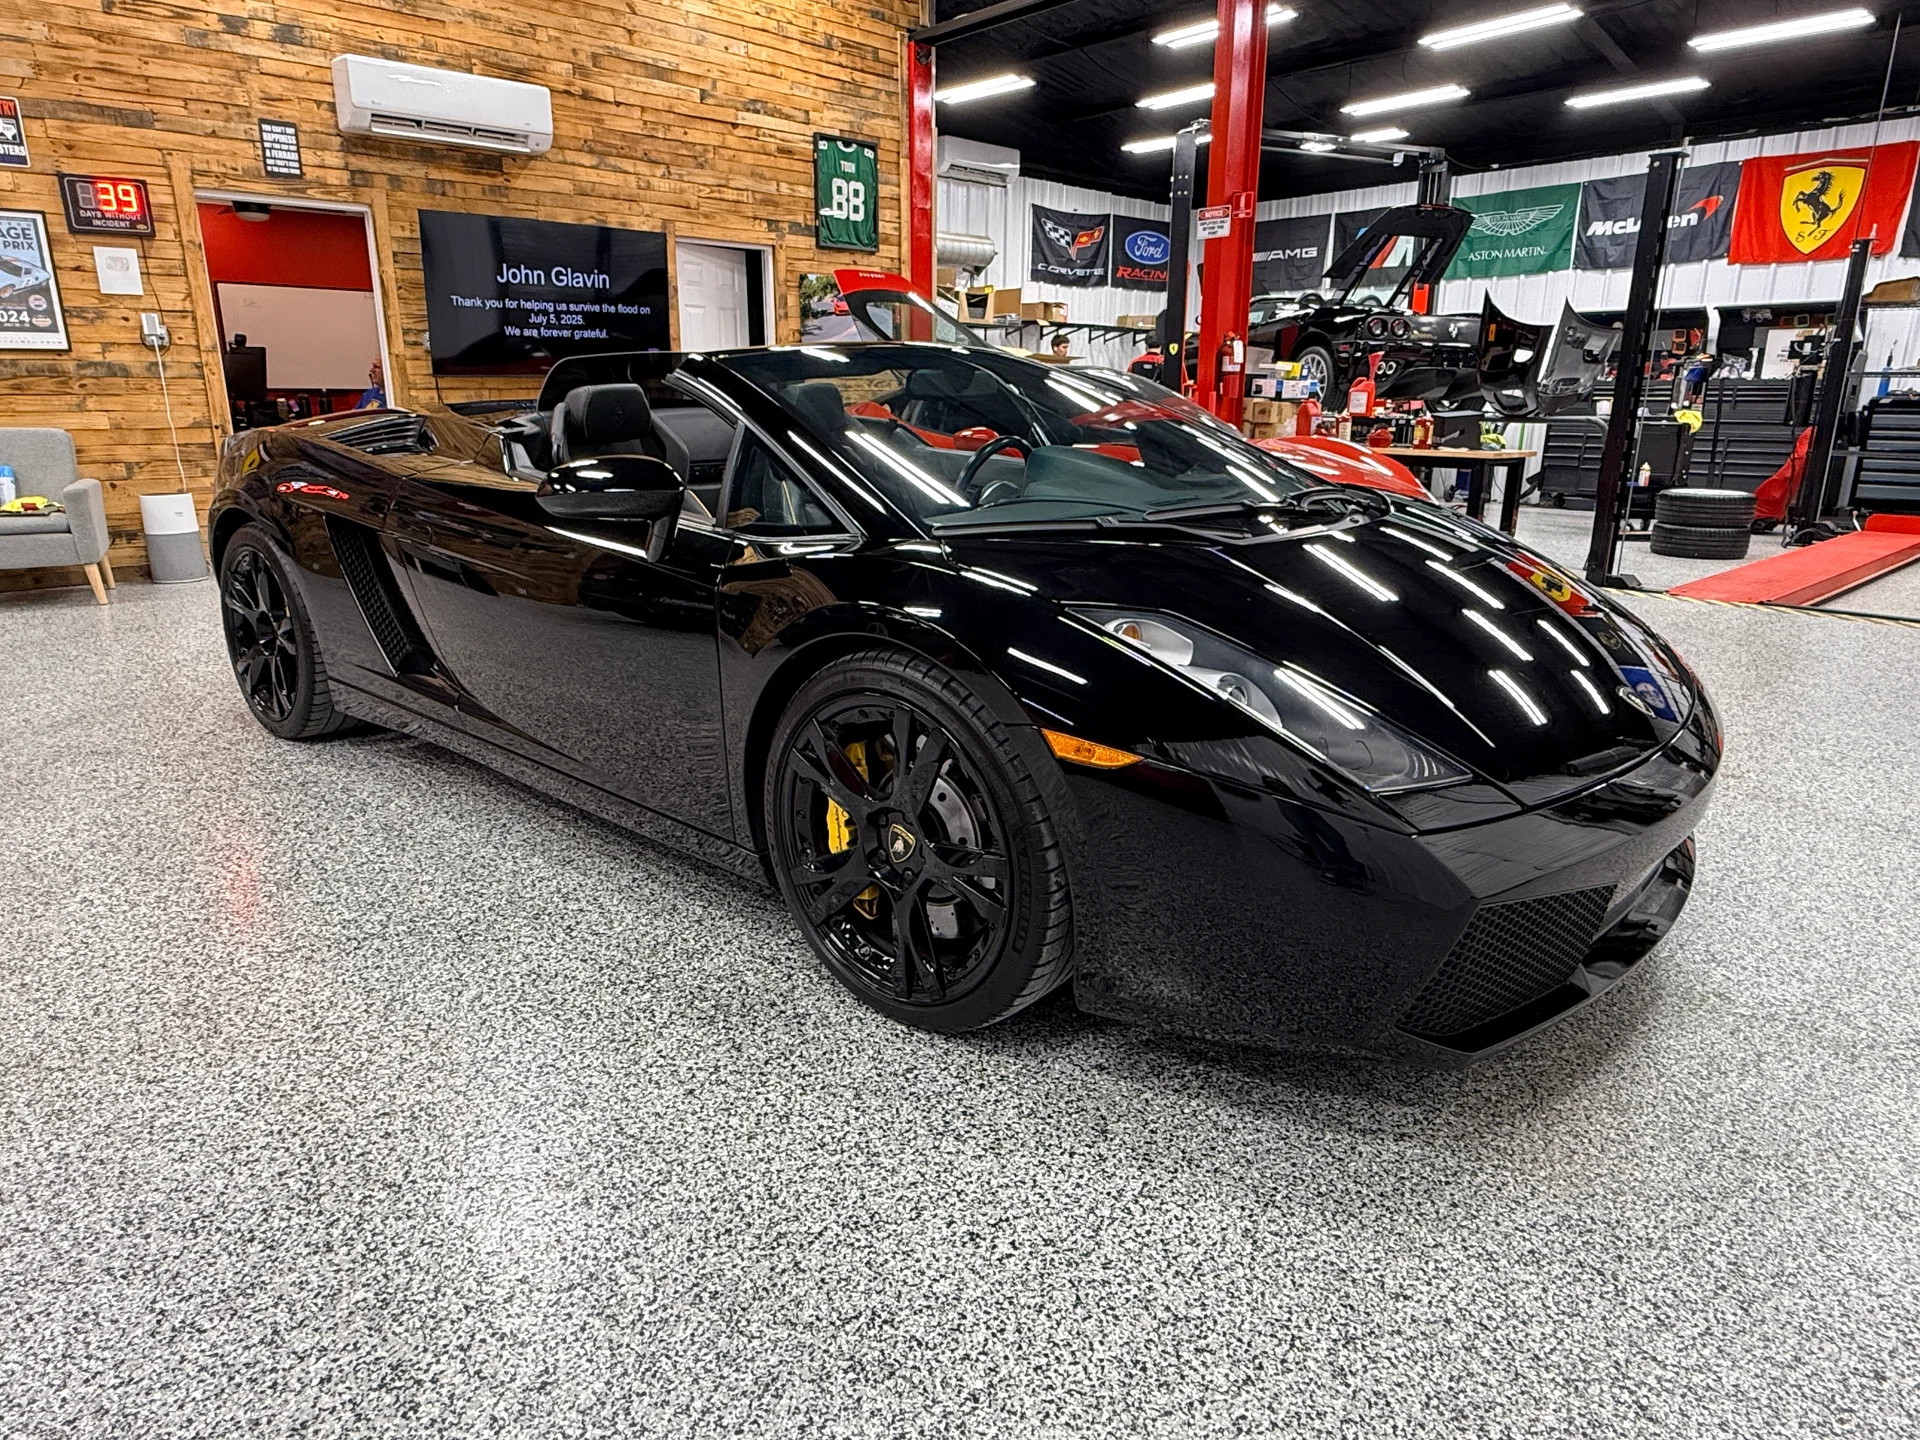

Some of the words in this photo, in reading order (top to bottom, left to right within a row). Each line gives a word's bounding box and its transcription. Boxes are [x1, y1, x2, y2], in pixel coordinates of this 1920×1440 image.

[262, 132, 297, 144] HAPPINESS
[271, 150, 299, 160] FERRARI
[97, 183, 138, 212] 39
[832, 178, 864, 221] 88
[79, 209, 102, 218] DAYS
[104, 211, 141, 220] WITHOUT
[1205, 210, 1223, 218] NOTICE
[92, 218, 130, 228] INCIDENT
[1586, 212, 1698, 236] McLen
[1795, 231, 1805, 243] S
[3, 240, 36, 251] PRIX
[1134, 234, 1165, 258] Ford
[1268, 247, 1318, 261] AMG
[1467, 250, 1503, 261] ASTON
[1504, 246, 1545, 258] MARTIN
[496, 263, 545, 285] John
[551, 266, 610, 289] Glavin
[1038, 262, 1105, 276] CORVETTE
[1116, 266, 1168, 280] RACIN
[450, 295, 483, 308] Thank
[484, 299, 503, 310] you
[505, 298, 518, 308] for
[520, 299, 554, 312] helping
[556, 302, 567, 311] us
[569, 302, 600, 312] survive
[602, 303, 616, 313] the
[617, 303, 639, 314] flood
[639, 306, 651, 314] on
[528, 313, 547, 325] July
[549, 313, 558, 325] 5,
[560, 314, 586, 325] 2025.
[504, 325, 521, 336] We
[523, 328, 539, 337] are
[540, 326, 572, 337] forever
[574, 328, 609, 340] grateful.
